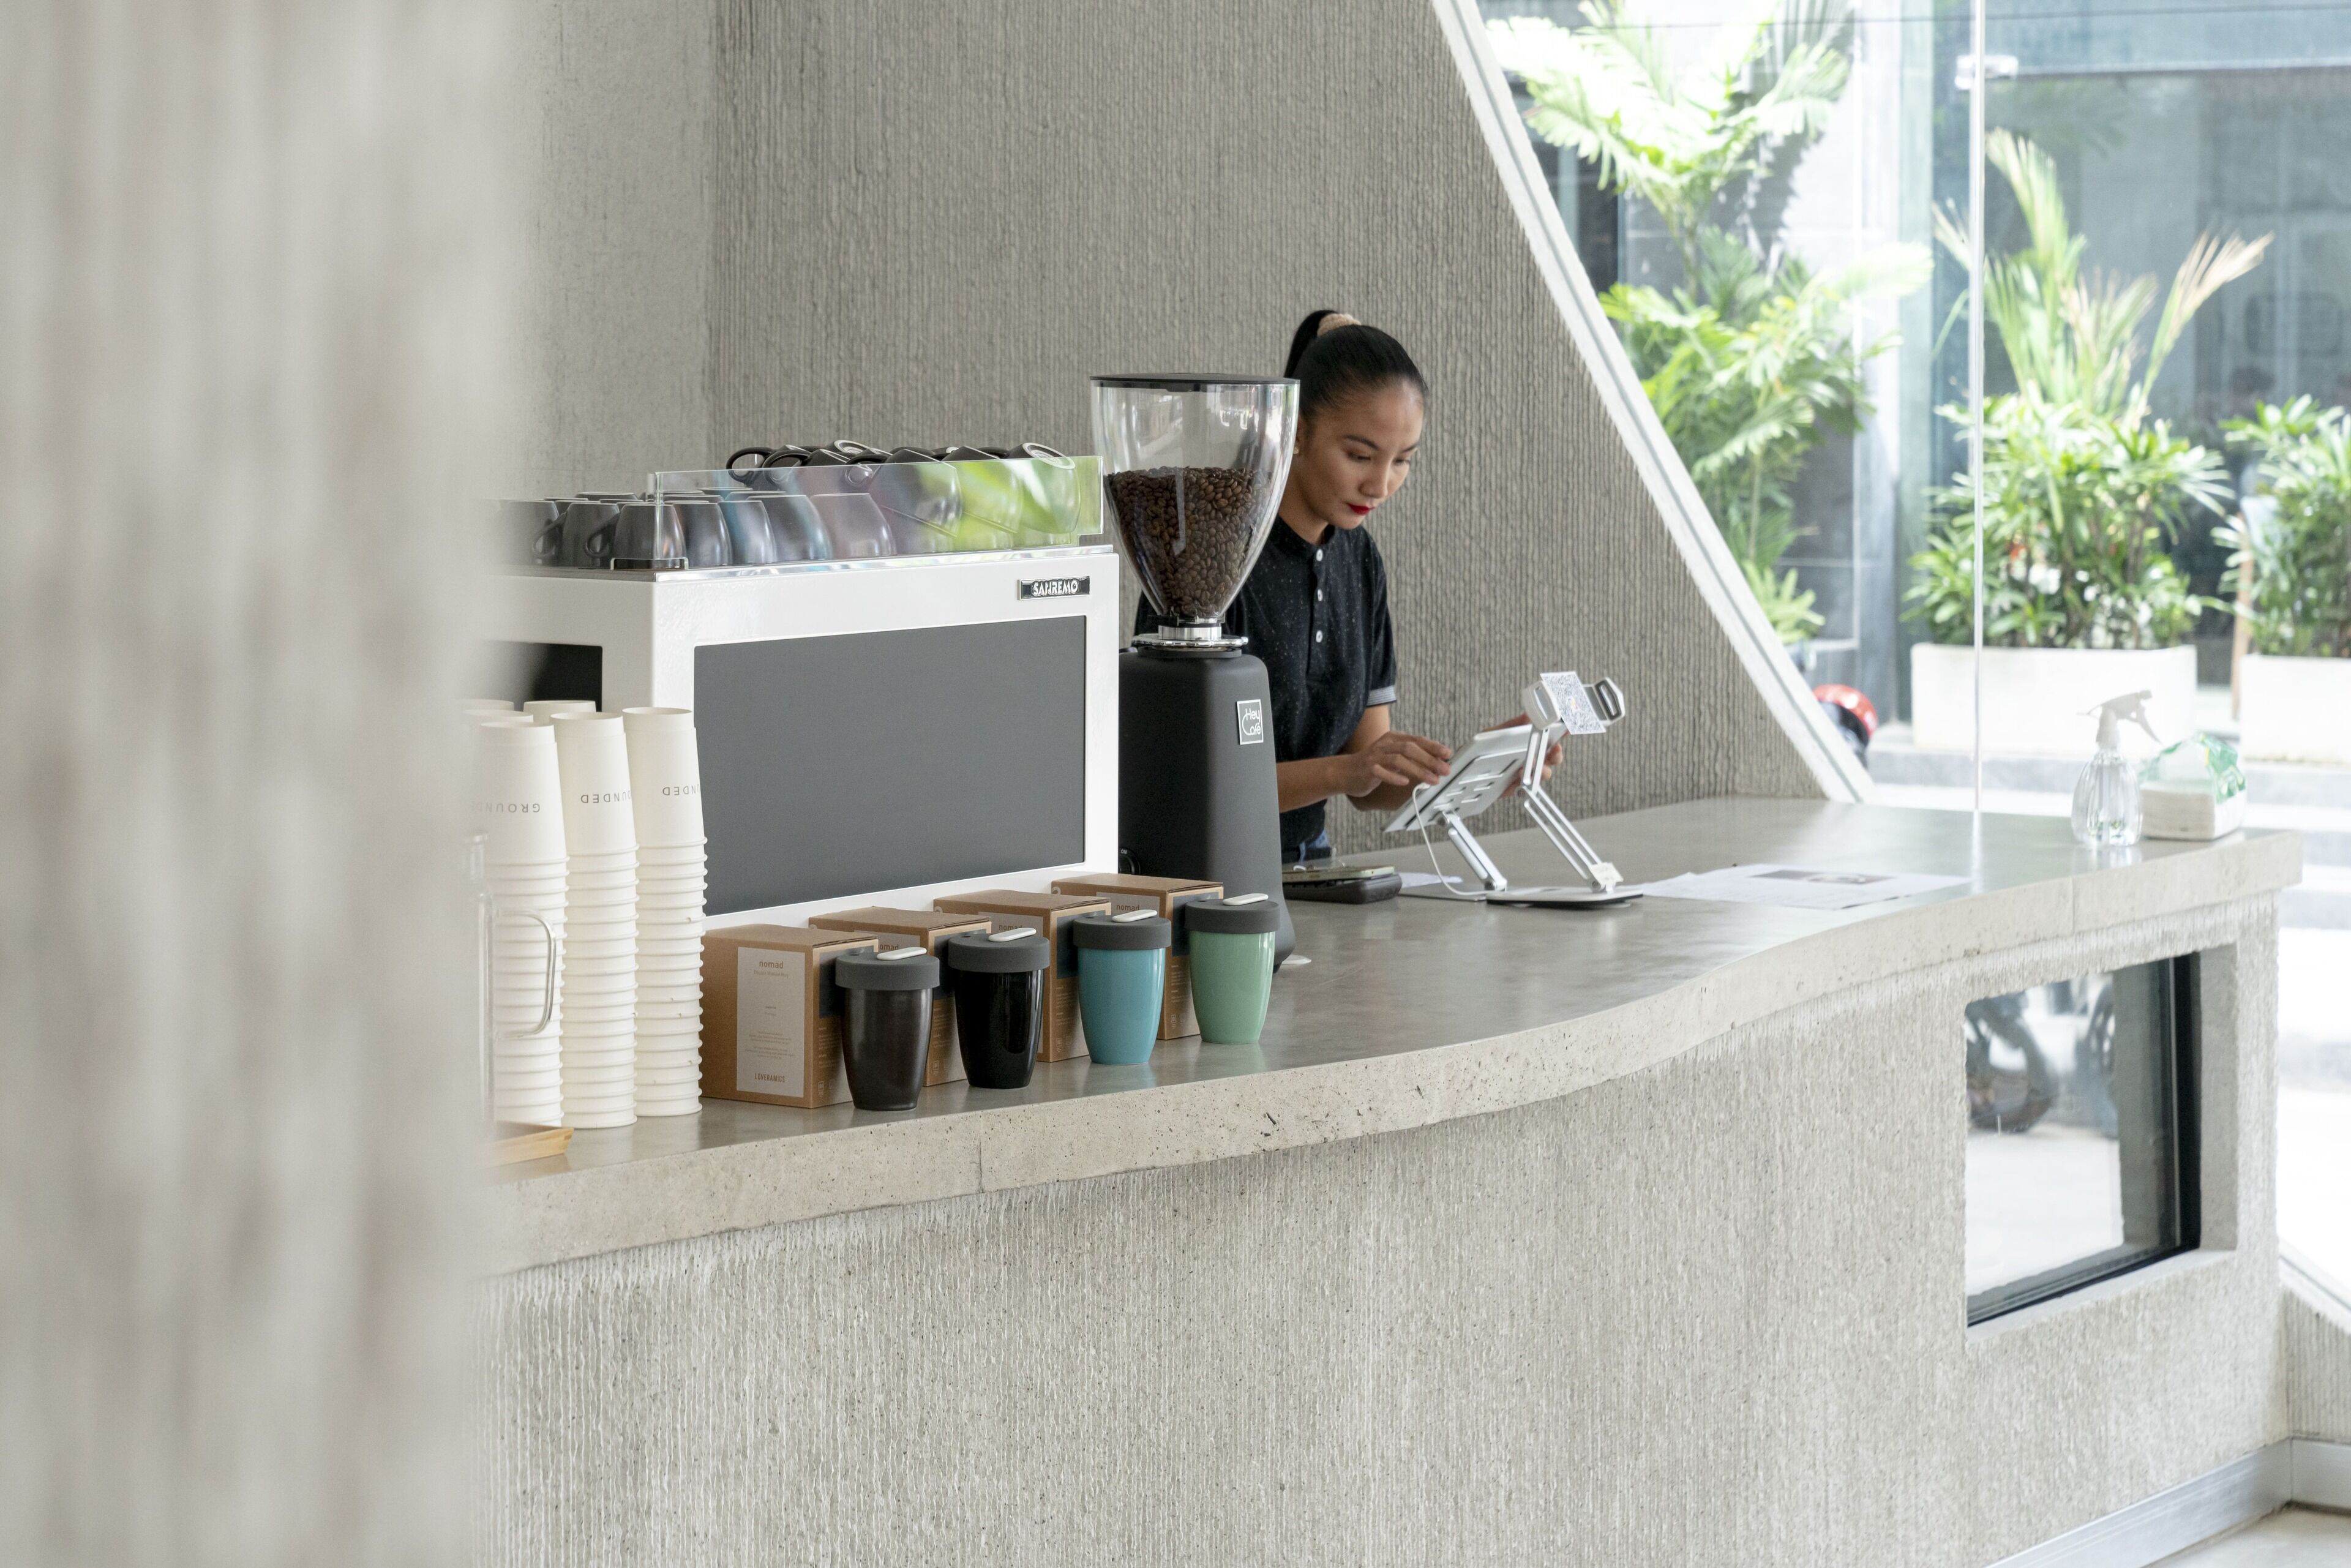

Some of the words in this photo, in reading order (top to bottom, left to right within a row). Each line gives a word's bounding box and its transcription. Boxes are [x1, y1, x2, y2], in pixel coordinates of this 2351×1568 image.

[1033, 579, 1078, 596] SANREMO
[1245, 708, 1261, 724] Hey
[662, 784, 700, 796] UNDED
[580, 790, 631, 803] OUNDED
[472, 801, 541, 813] GROUND
[759, 961, 784, 969] nomad
[754, 1073, 786, 1083] LOVERAMICS
